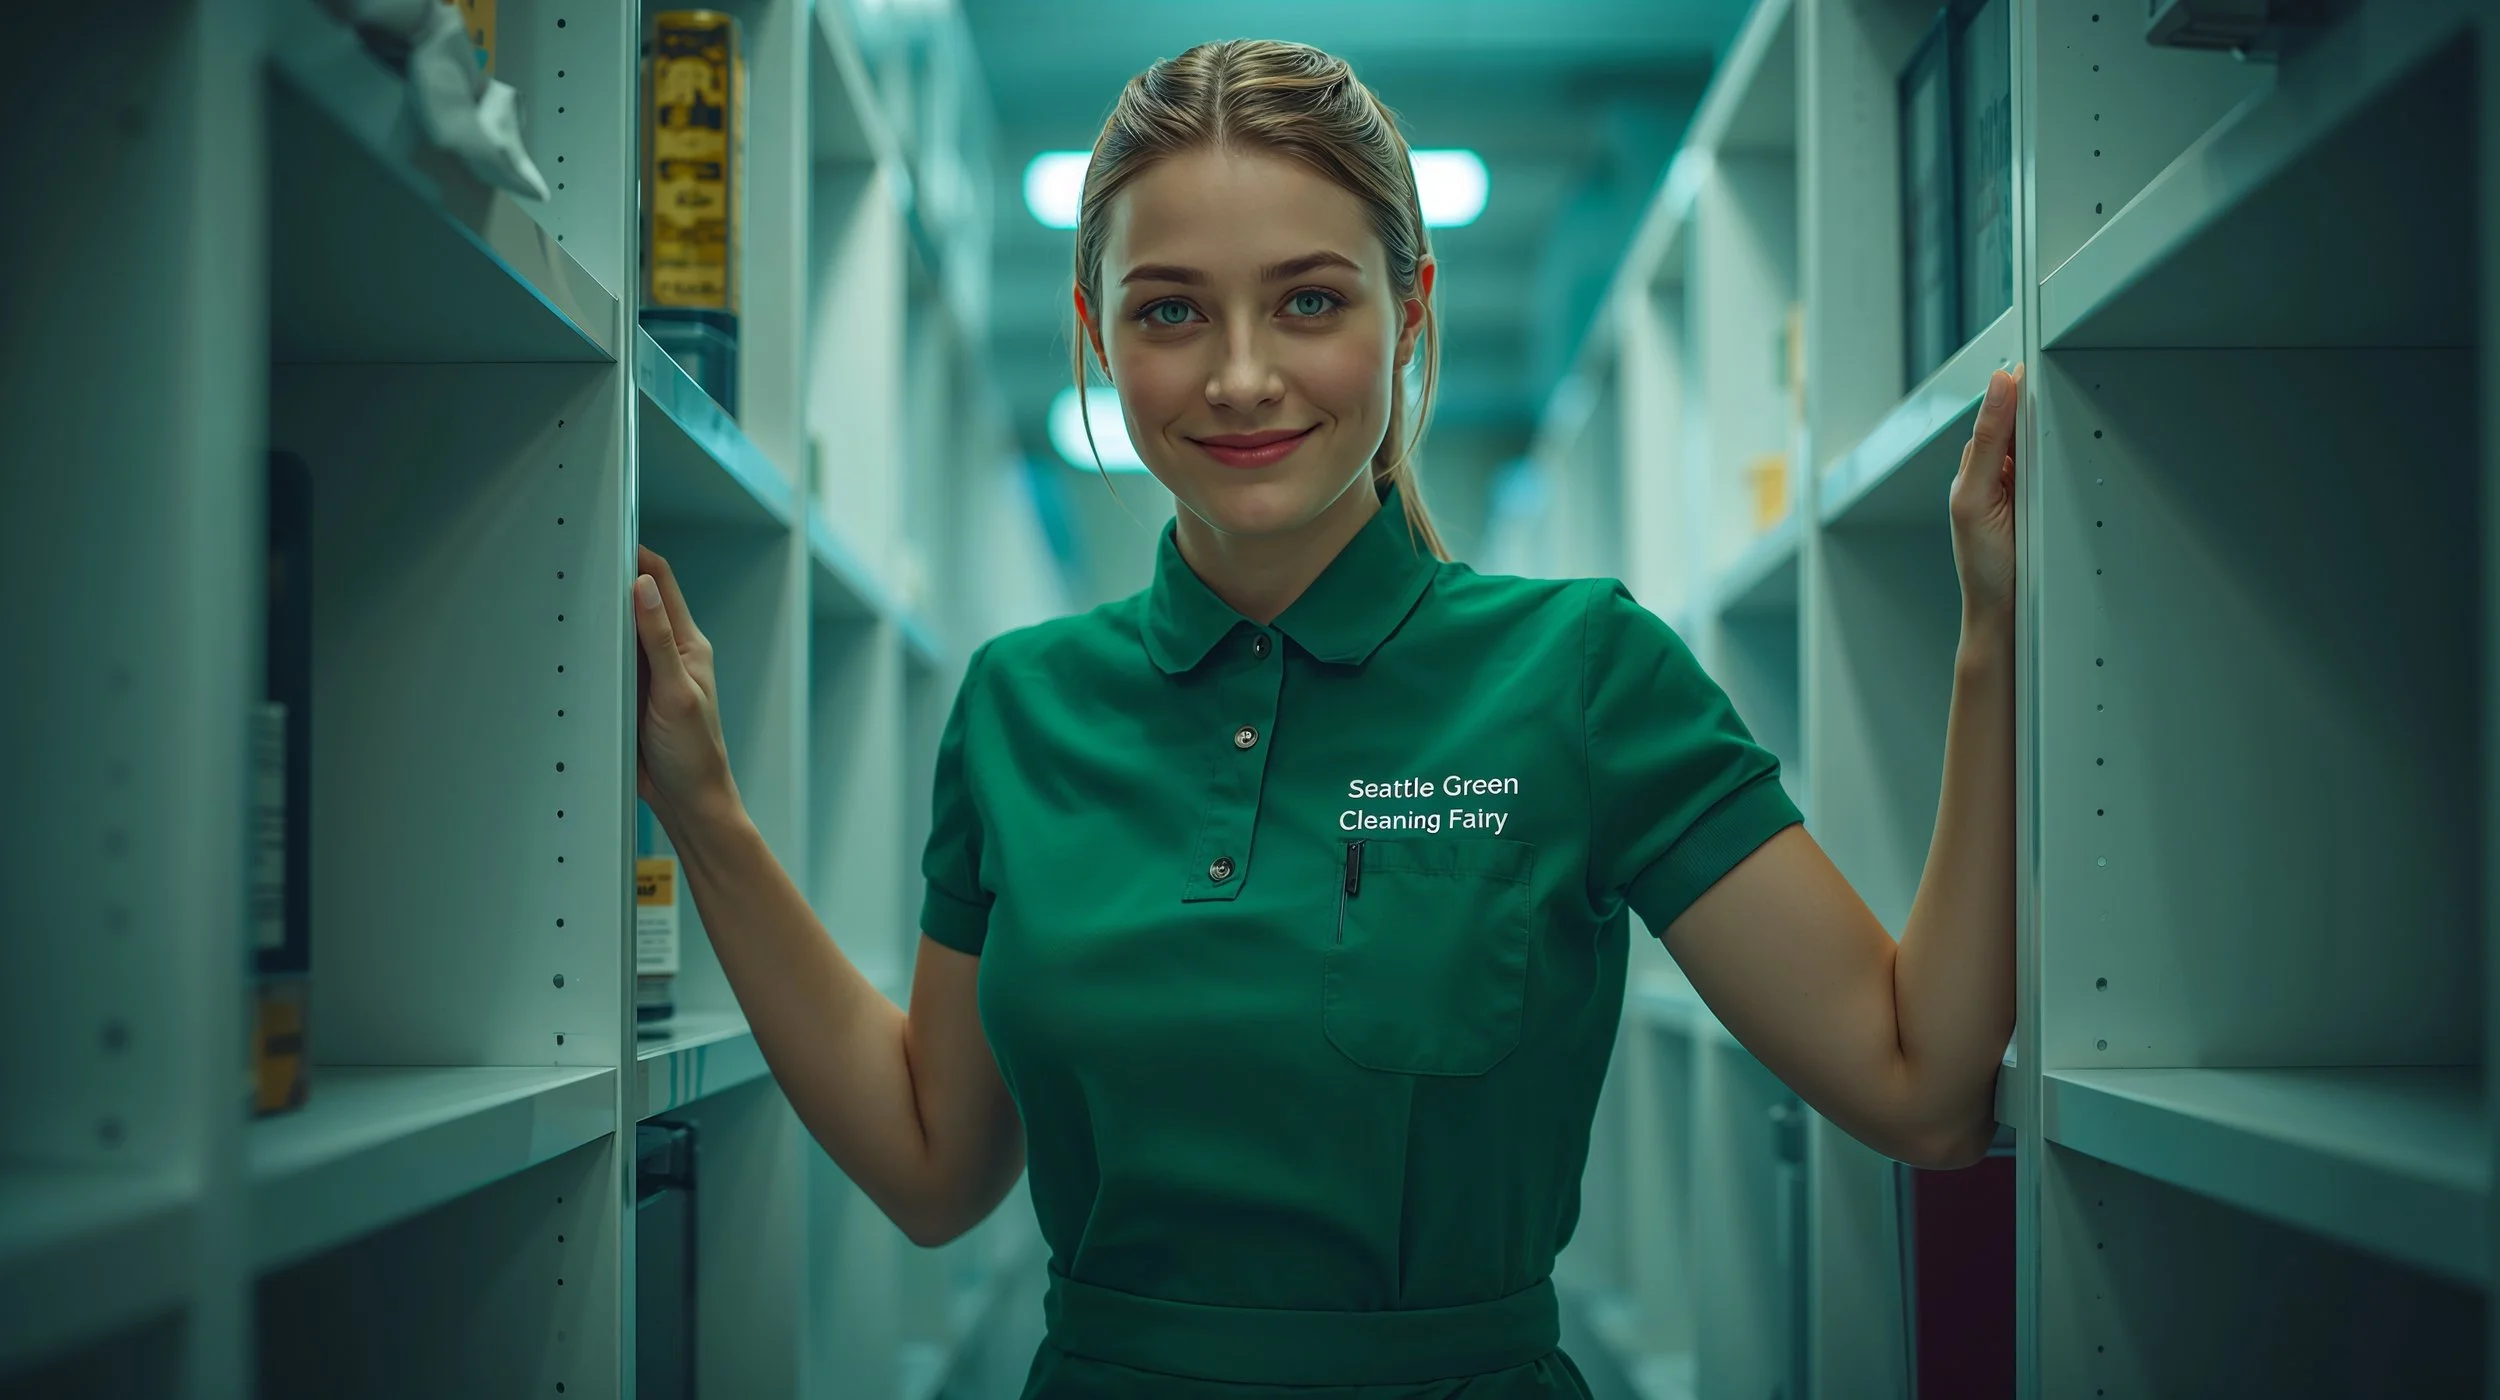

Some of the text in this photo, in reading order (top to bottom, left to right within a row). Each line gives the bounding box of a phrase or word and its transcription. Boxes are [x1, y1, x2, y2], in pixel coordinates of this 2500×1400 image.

[1348, 775, 1519, 798] Seattle Green
[1339, 808, 1509, 836] Cleaning Fairy
